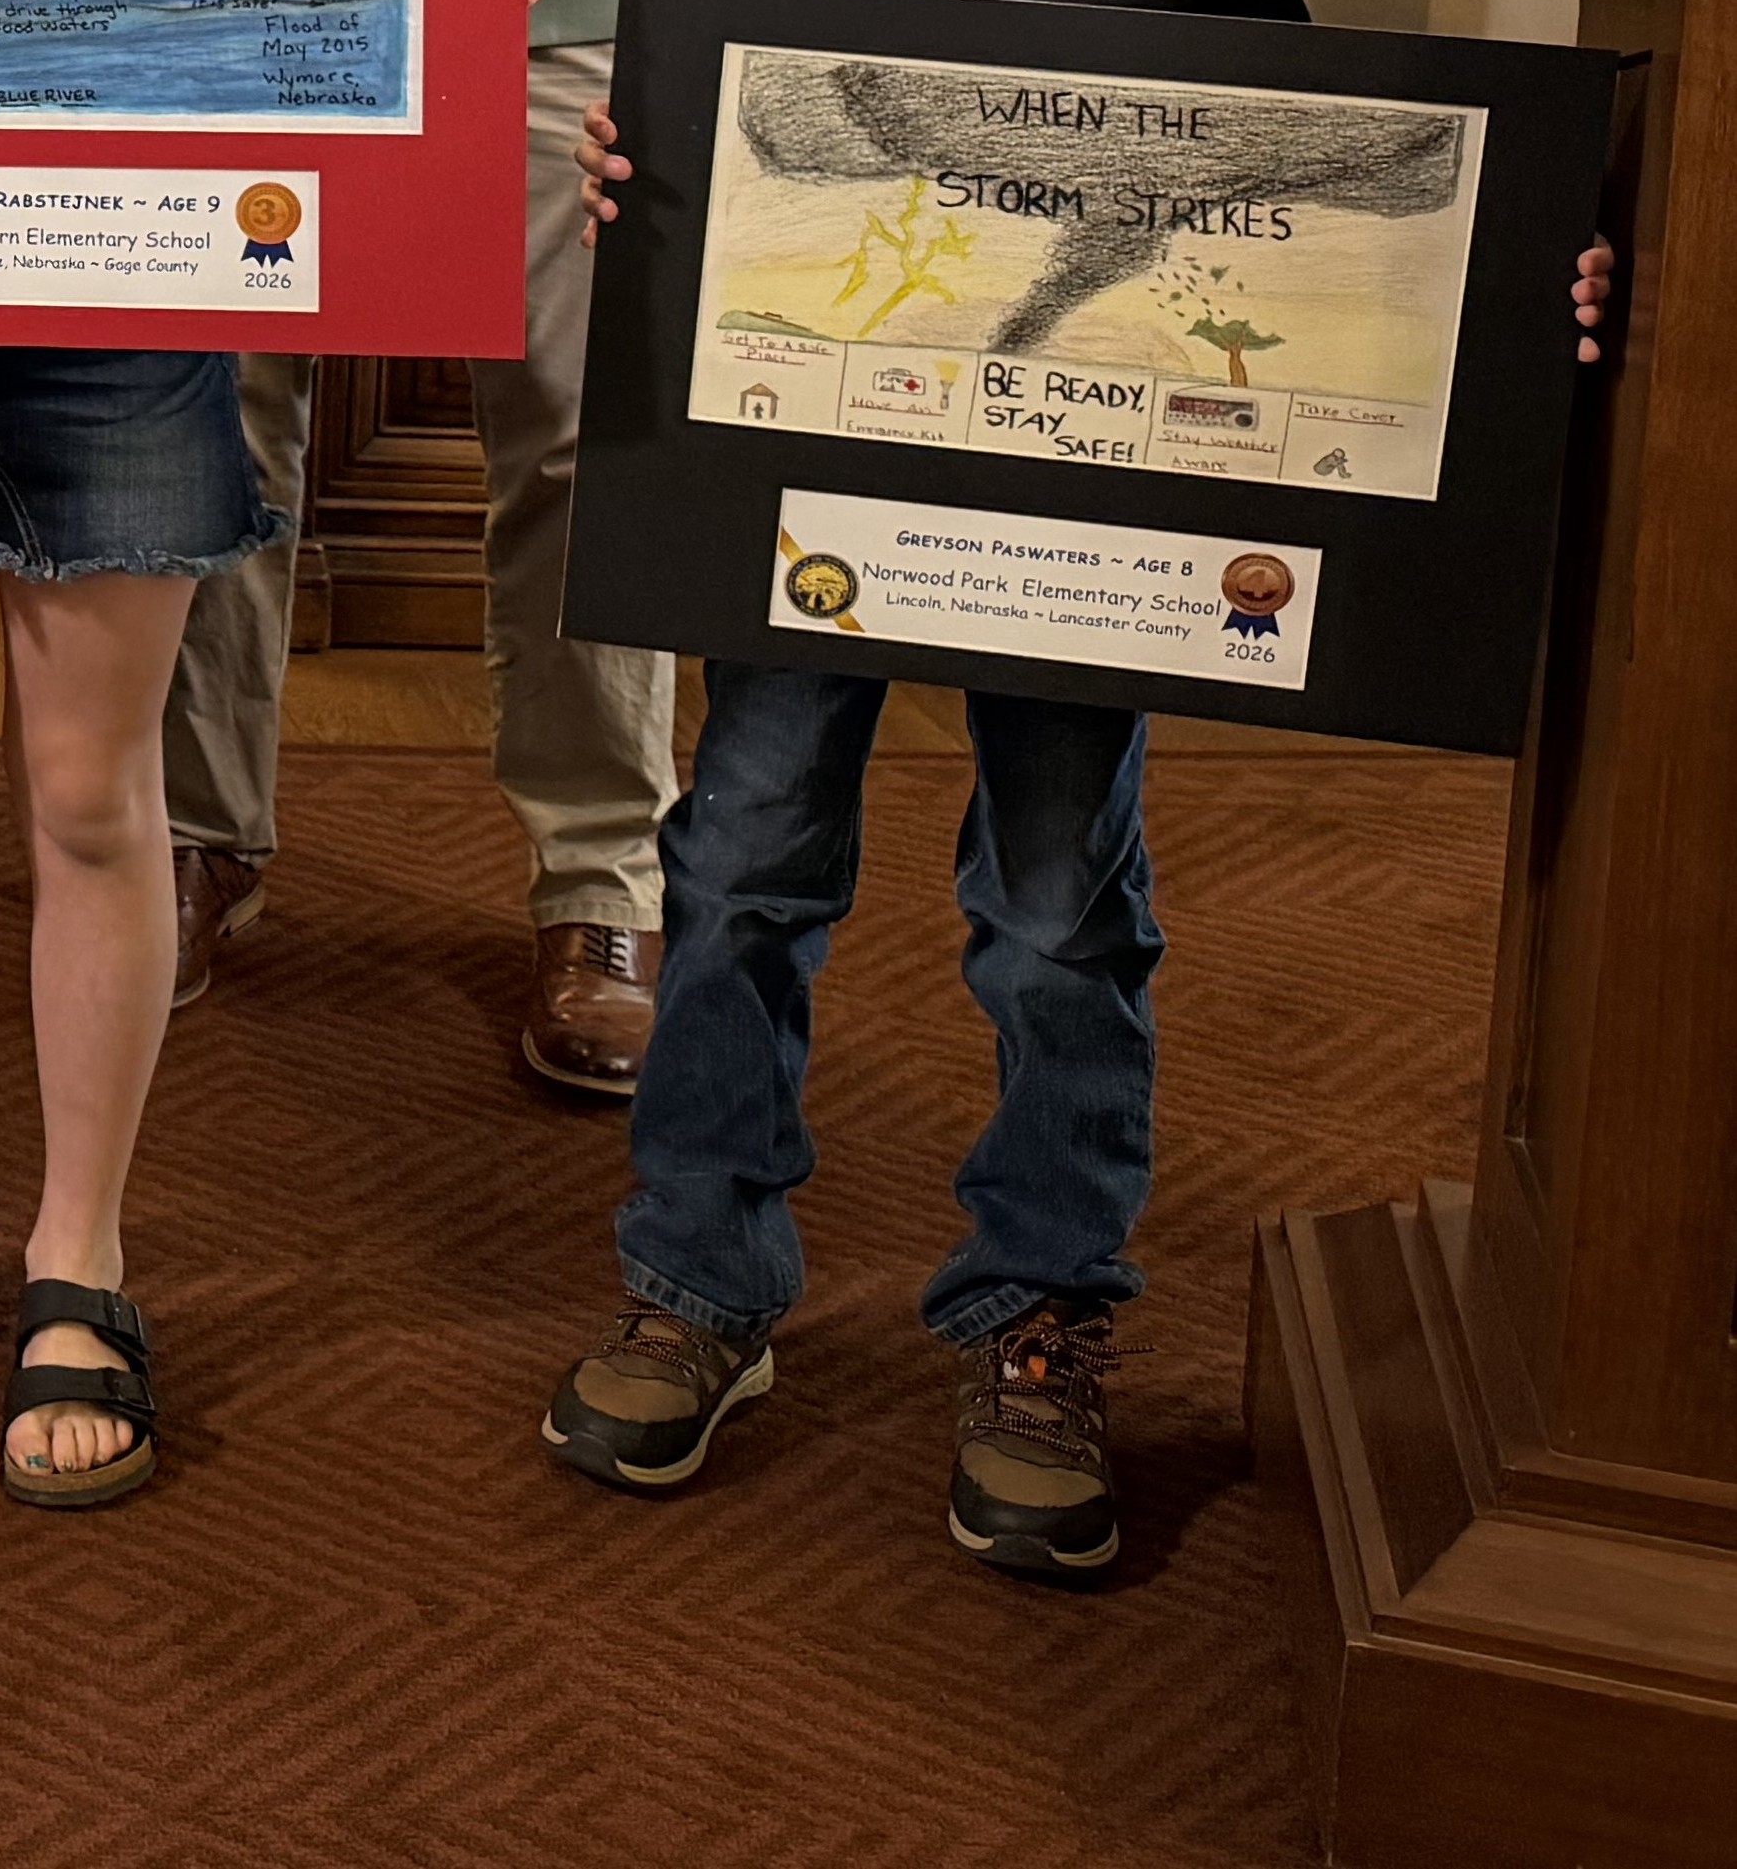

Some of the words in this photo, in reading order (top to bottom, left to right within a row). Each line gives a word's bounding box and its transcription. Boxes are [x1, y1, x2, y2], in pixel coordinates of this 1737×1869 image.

[264, 14, 323, 33] Flood
[339, 12, 360, 31] of
[262, 38, 307, 62] May
[321, 36, 369, 54] 2015
[45, 88, 97, 103] RIVER
[278, 89, 377, 106] Nebraska
[975, 84, 1106, 132] WHEN
[1125, 101, 1211, 140] THE
[158, 195, 198, 213] AGE
[207, 195, 221, 214] 9
[935, 170, 1084, 221] STORM
[1113, 187, 1293, 241] STRIKES
[26, 229, 139, 252] Elementary
[144, 231, 212, 250] School
[12, 255, 86, 271] Nebraska
[104, 258, 142, 274] Gage
[146, 259, 199, 275] County
[244, 271, 293, 289] 2026
[983, 360, 1027, 399] BE
[983, 404, 1067, 436] STAY
[1053, 435, 1135, 463] SAFE!
[895, 529, 984, 555] GREYSON
[991, 540, 1101, 568] PASWATERS
[1132, 556, 1172, 576] AGE
[1180, 560, 1194, 577] 8
[862, 561, 955, 590] Norwood
[960, 571, 1009, 595] Park
[1022, 579, 1143, 612] Elementary
[1149, 592, 1222, 618] School
[885, 591, 947, 613] Lincoln,
[950, 597, 1029, 621] Nebraska
[1048, 608, 1130, 632] Lancaster
[1134, 618, 1192, 642] County
[1224, 642, 1276, 665] 2026
